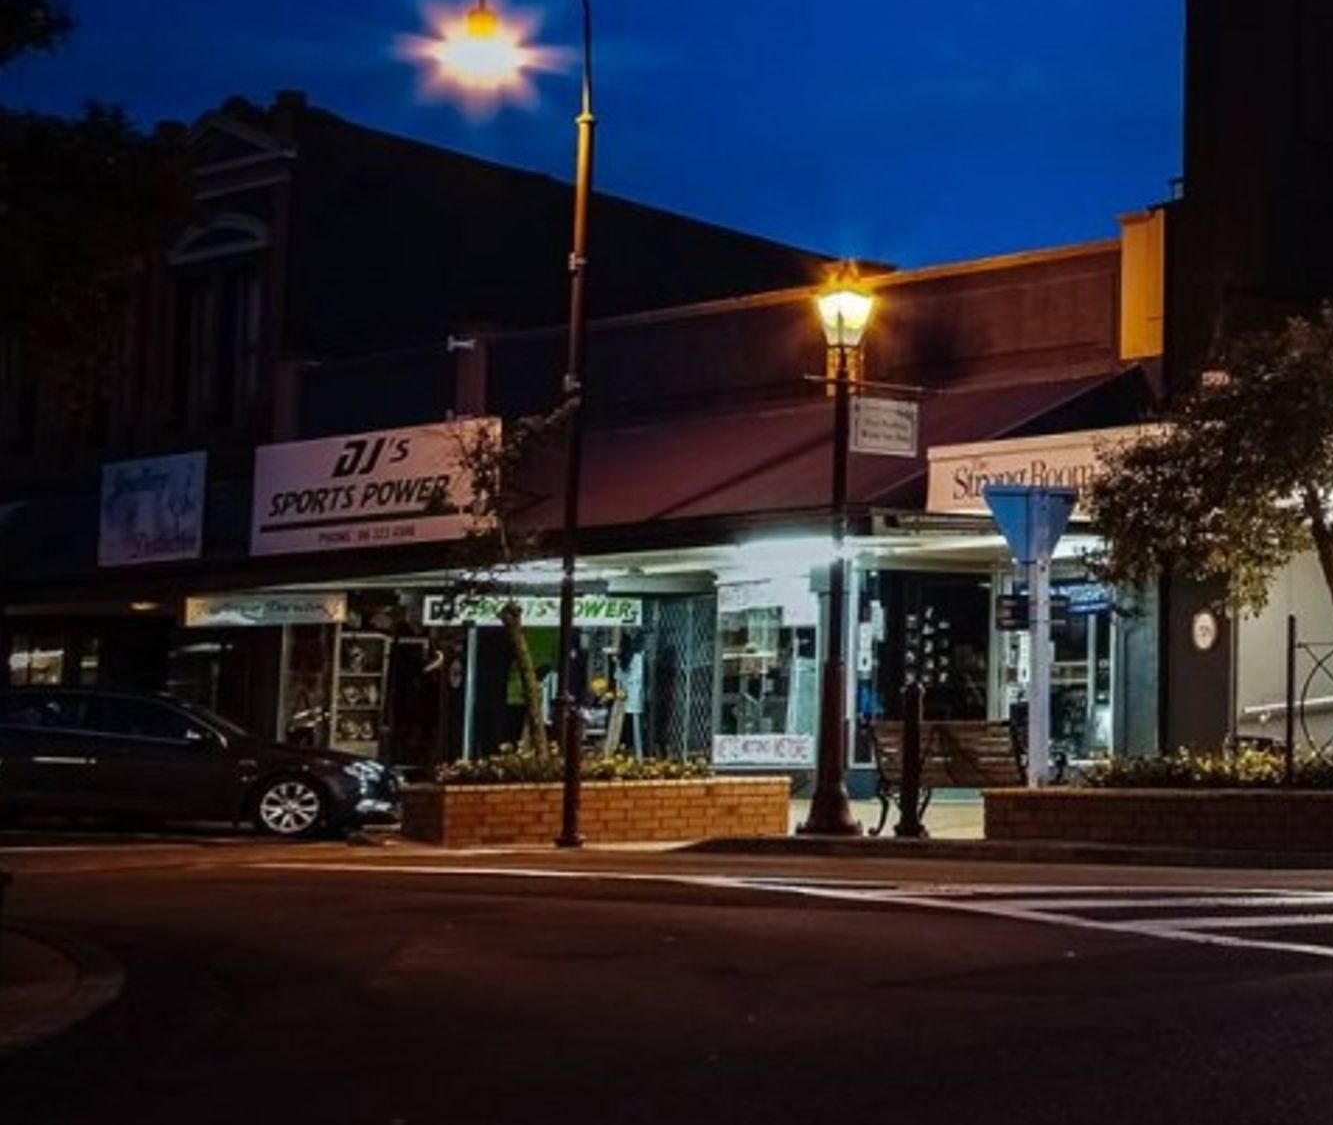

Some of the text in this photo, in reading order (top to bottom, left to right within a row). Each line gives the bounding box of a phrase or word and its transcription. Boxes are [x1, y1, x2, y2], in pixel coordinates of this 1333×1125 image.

[268, 475, 451, 517] SPORTS POWER
[572, 597, 631, 618] OWER
